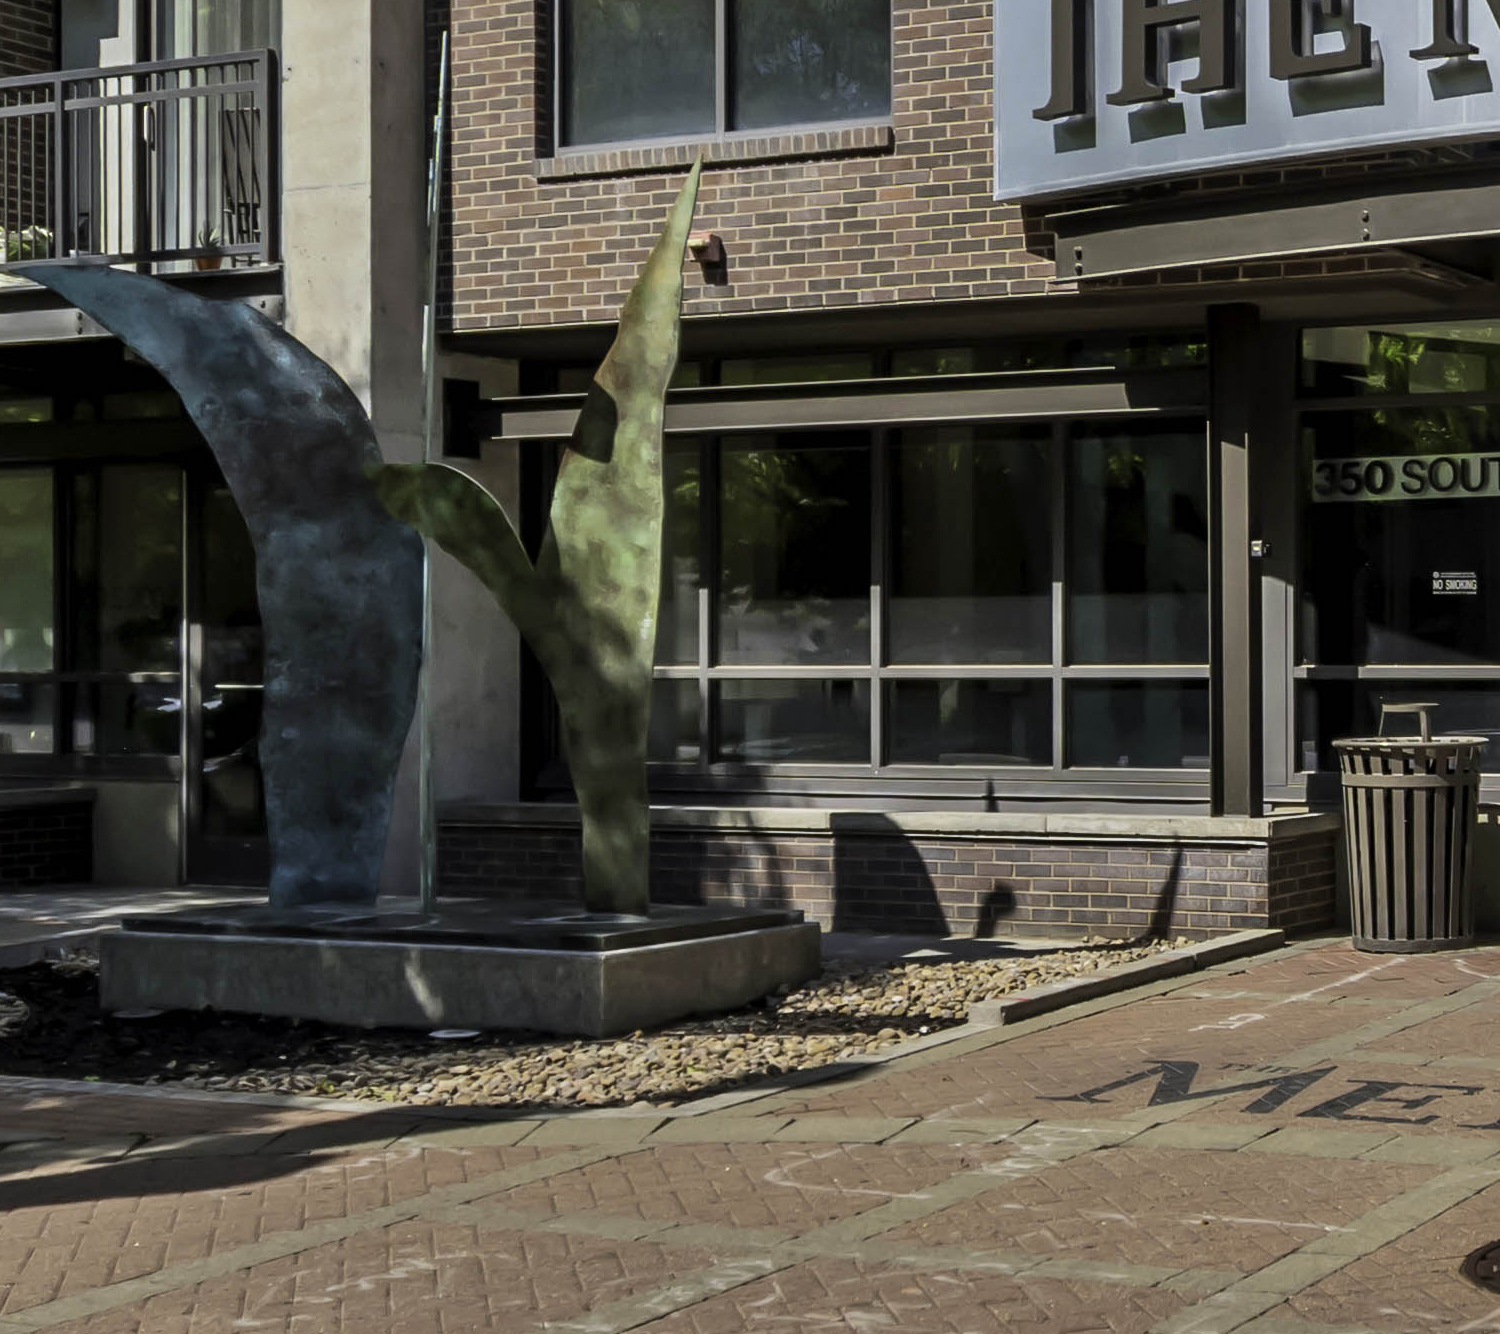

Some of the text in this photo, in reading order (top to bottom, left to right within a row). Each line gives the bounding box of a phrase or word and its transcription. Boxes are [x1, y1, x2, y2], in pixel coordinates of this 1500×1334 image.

[1314, 459, 1394, 496] 350
[1432, 579, 1478, 591] NO SMOKING
